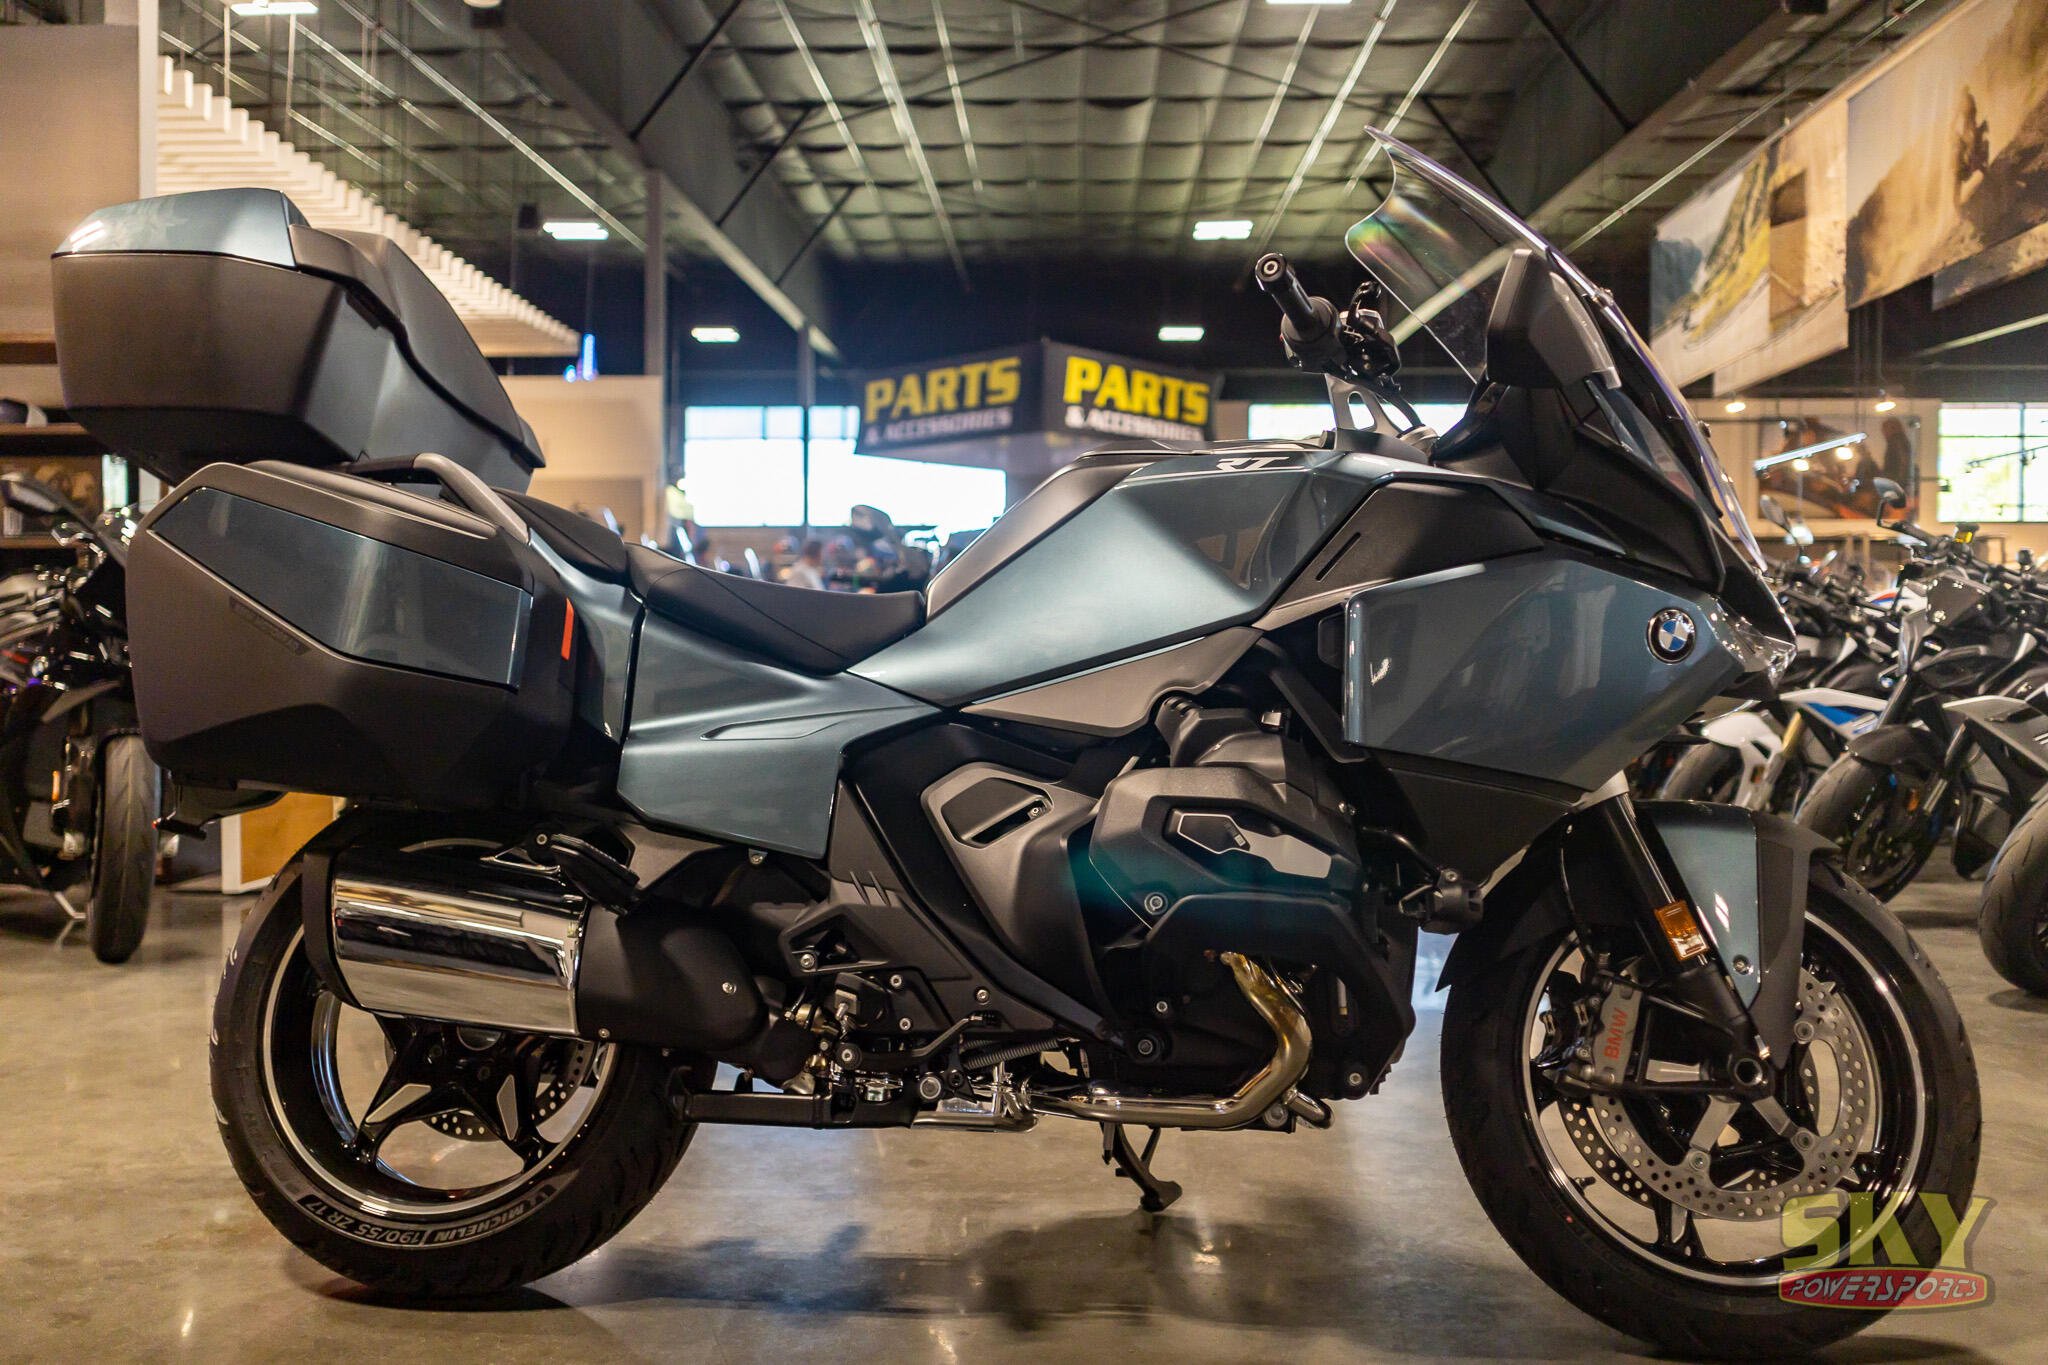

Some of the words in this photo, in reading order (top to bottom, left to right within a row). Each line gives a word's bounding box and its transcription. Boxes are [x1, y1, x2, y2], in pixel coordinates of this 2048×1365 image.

[865, 356, 1021, 424] PARTS
[1063, 355, 1210, 425] PARTS
[1216, 456, 1290, 472] RT
[1603, 1007, 1628, 1060] BMW
[305, 1200, 328, 1216] 17
[327, 1214, 355, 1230] ZR
[434, 1203, 525, 1242] MICHELIN
[355, 1223, 421, 1244] 190/55
